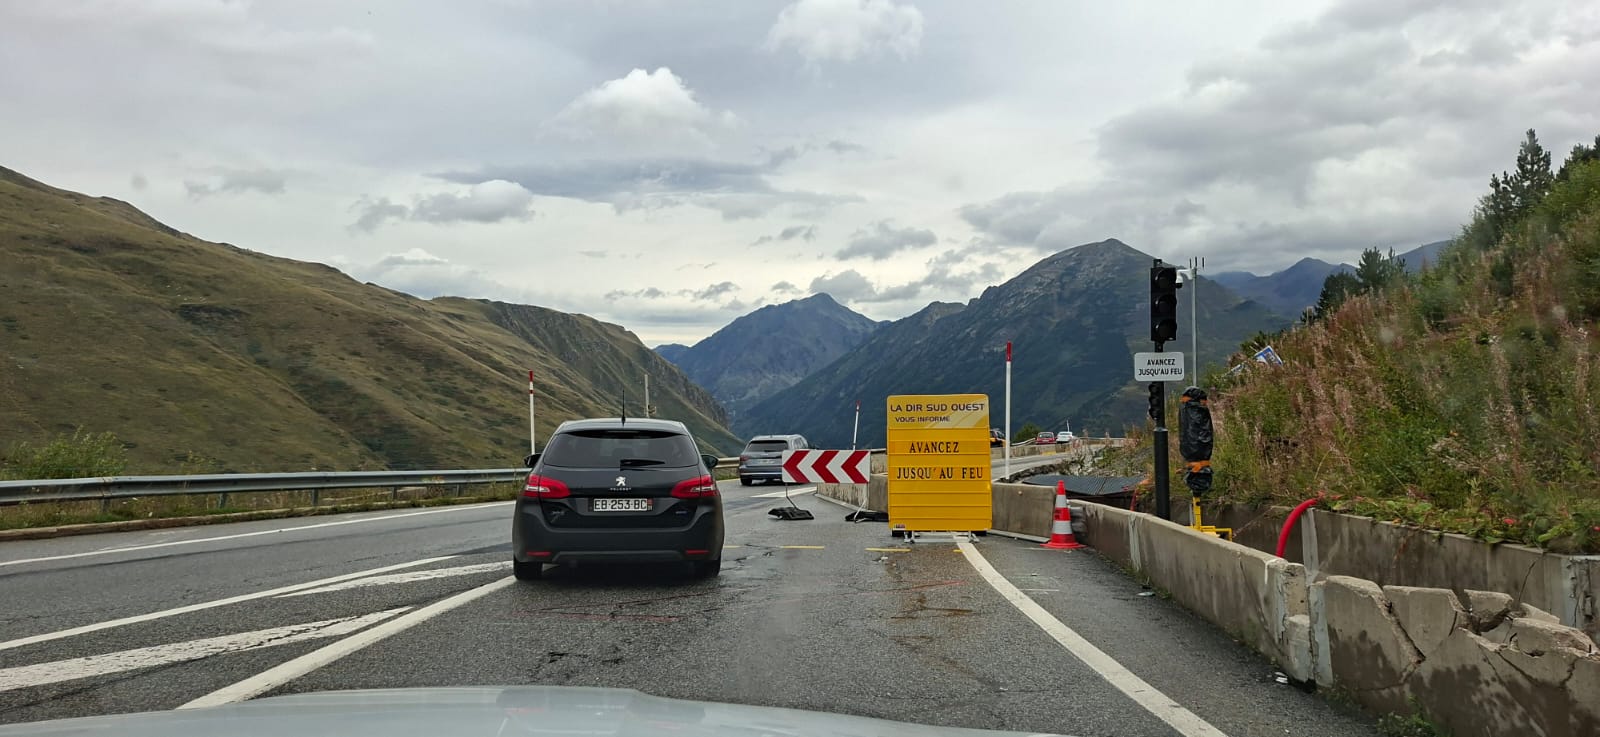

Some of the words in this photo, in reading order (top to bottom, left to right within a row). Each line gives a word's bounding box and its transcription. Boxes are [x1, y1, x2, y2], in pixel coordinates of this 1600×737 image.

[1138, 368, 1169, 376] JUSQU'AU
[890, 404, 902, 412] LA
[906, 404, 922, 412] DIR
[927, 403, 947, 411] SUD
[951, 403, 985, 411] OUEST
[909, 442, 959, 453] AVANCEZ
[962, 467, 983, 479] FEU
[594, 500, 647, 510] EB-253-BC
